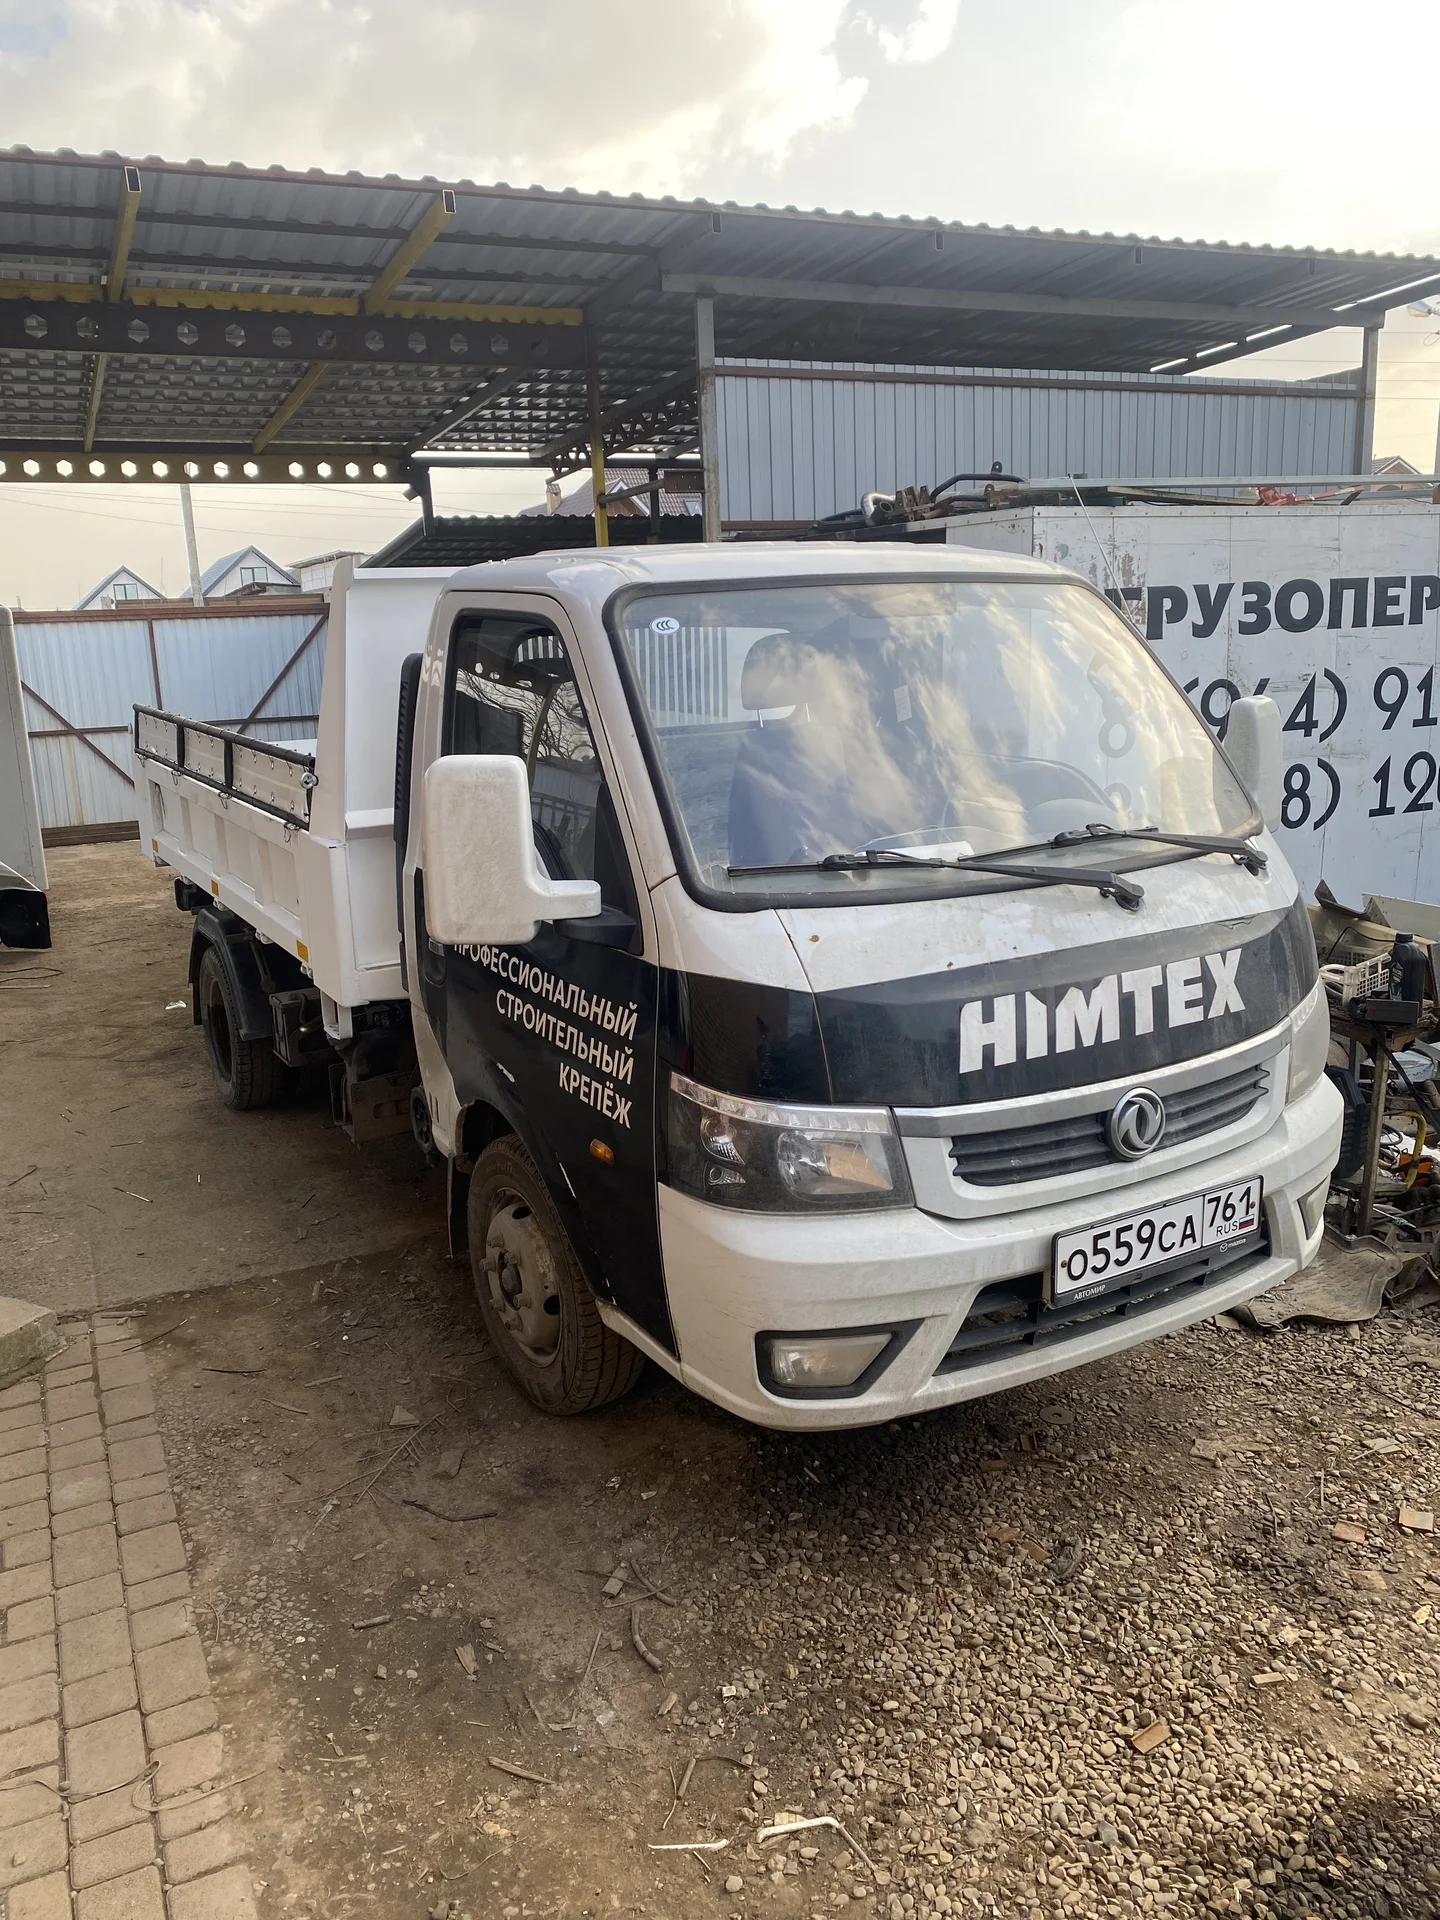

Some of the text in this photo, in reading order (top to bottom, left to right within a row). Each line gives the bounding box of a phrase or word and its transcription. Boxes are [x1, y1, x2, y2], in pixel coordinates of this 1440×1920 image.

[1183, 667, 1348, 743] 94)
[1368, 750, 1440, 819] 12
[496, 988, 634, 1085] СТРОИТЕЛЬНЫЙ
[959, 948, 1246, 1074] HIMTEX
[559, 1062, 633, 1129] КРЕПЁЖ
[1207, 1186, 1252, 1228] 761
[1216, 1221, 1238, 1237] RUS
[1073, 1284, 1106, 1300] АВТОМИР
